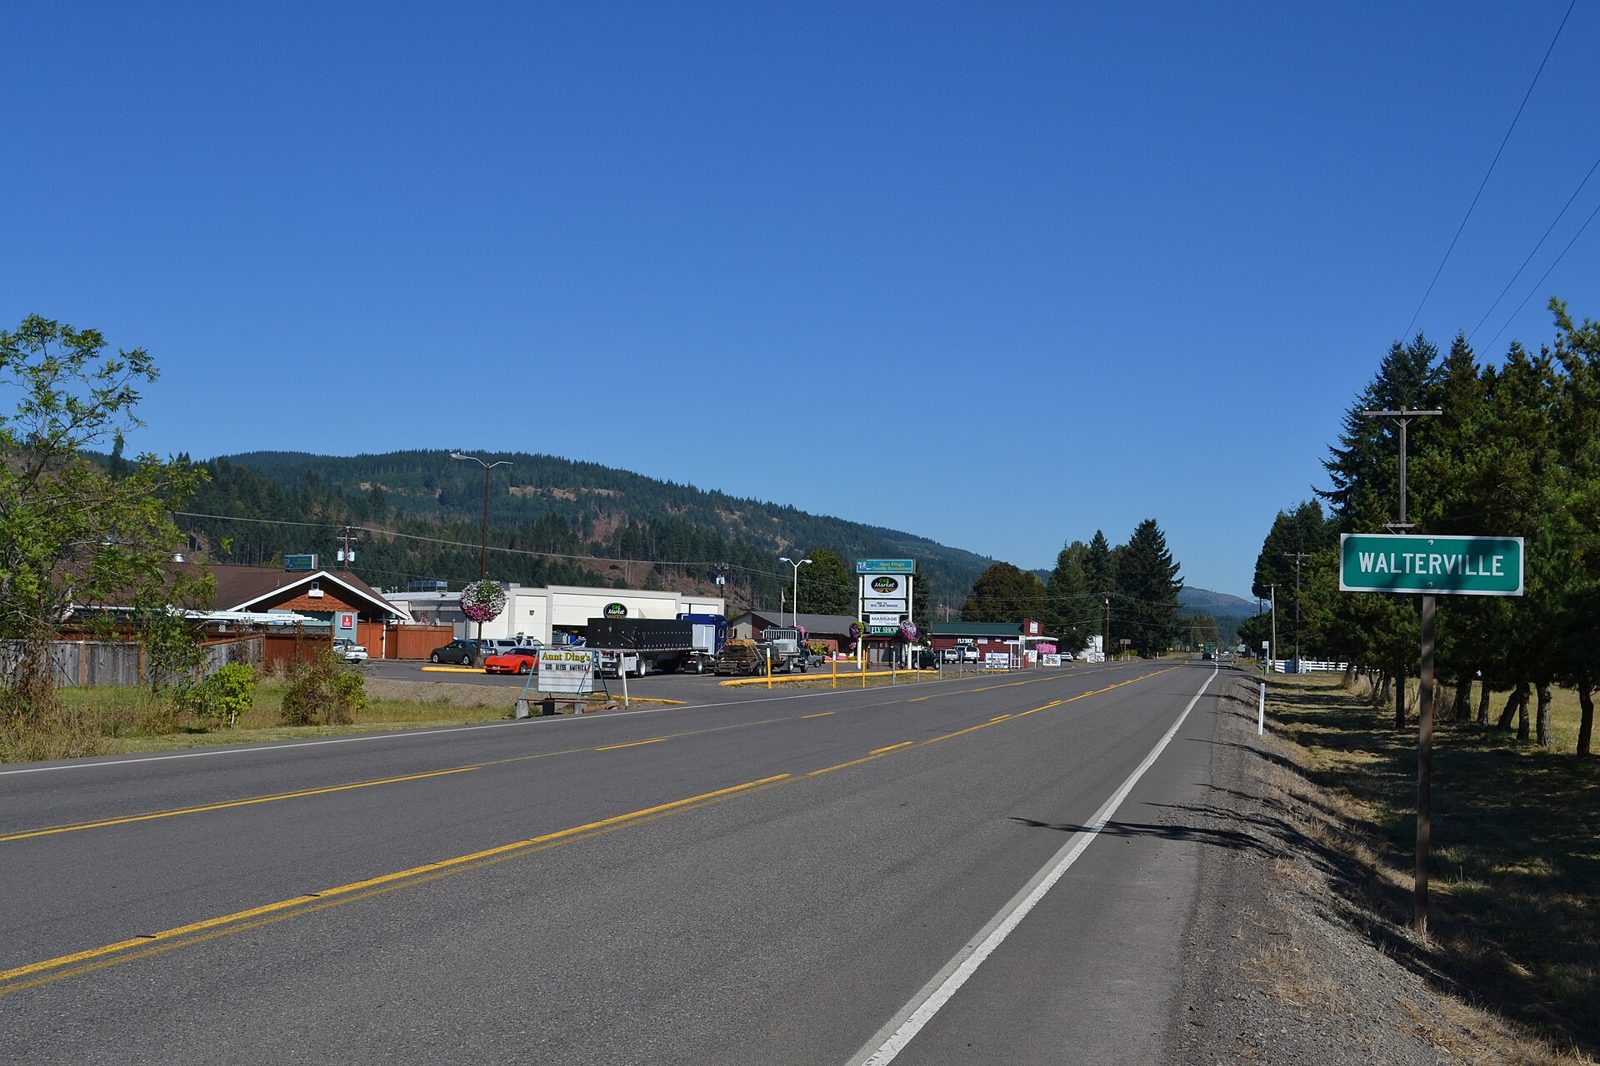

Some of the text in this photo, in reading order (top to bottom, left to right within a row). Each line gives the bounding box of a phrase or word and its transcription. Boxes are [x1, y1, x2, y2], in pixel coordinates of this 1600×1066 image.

[1359, 552, 1504, 577] WALTERVILLE
[871, 626, 899, 634] FLY SHOP
[542, 652, 591, 663] Aunt Ding's
